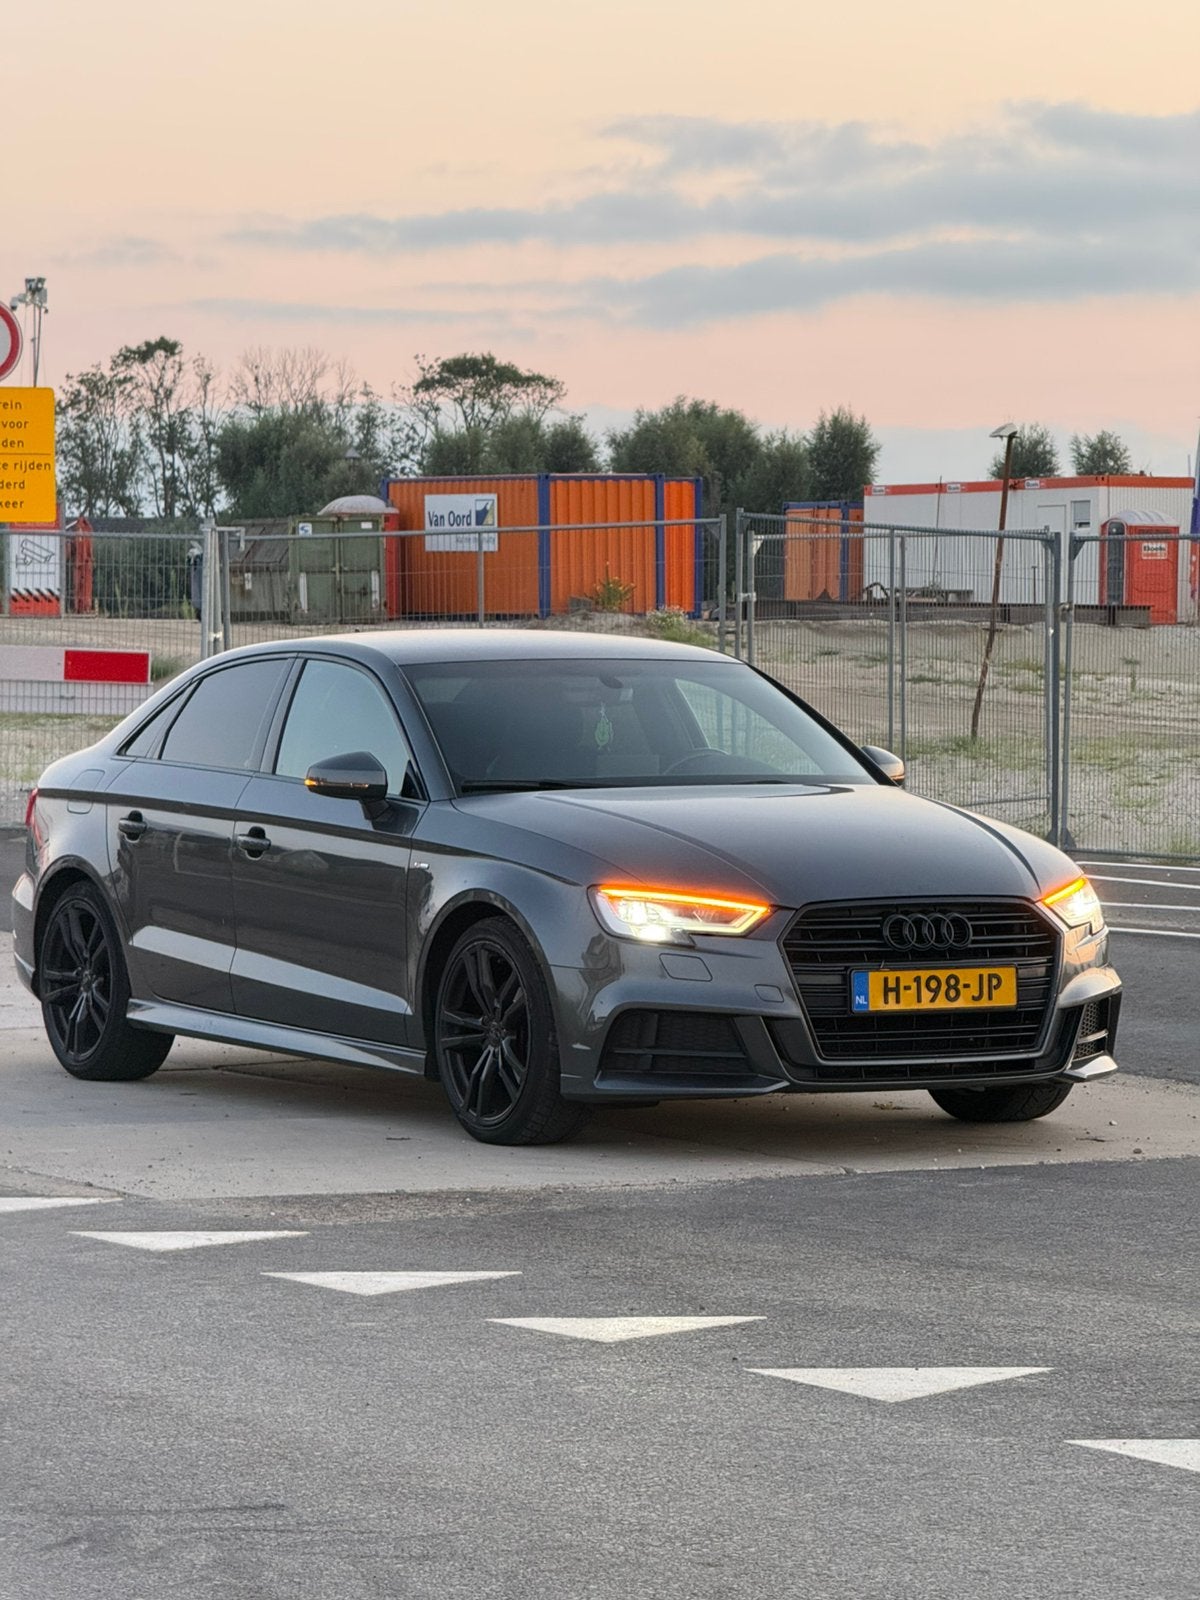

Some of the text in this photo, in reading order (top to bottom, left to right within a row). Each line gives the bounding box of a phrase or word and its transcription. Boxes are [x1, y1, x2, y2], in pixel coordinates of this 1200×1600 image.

[2, 420, 29, 429] voor
[14, 460, 51, 473] rijden
[428, 509, 472, 527] Van Oord
[856, 973, 1003, 1005] NL H-198-JP
